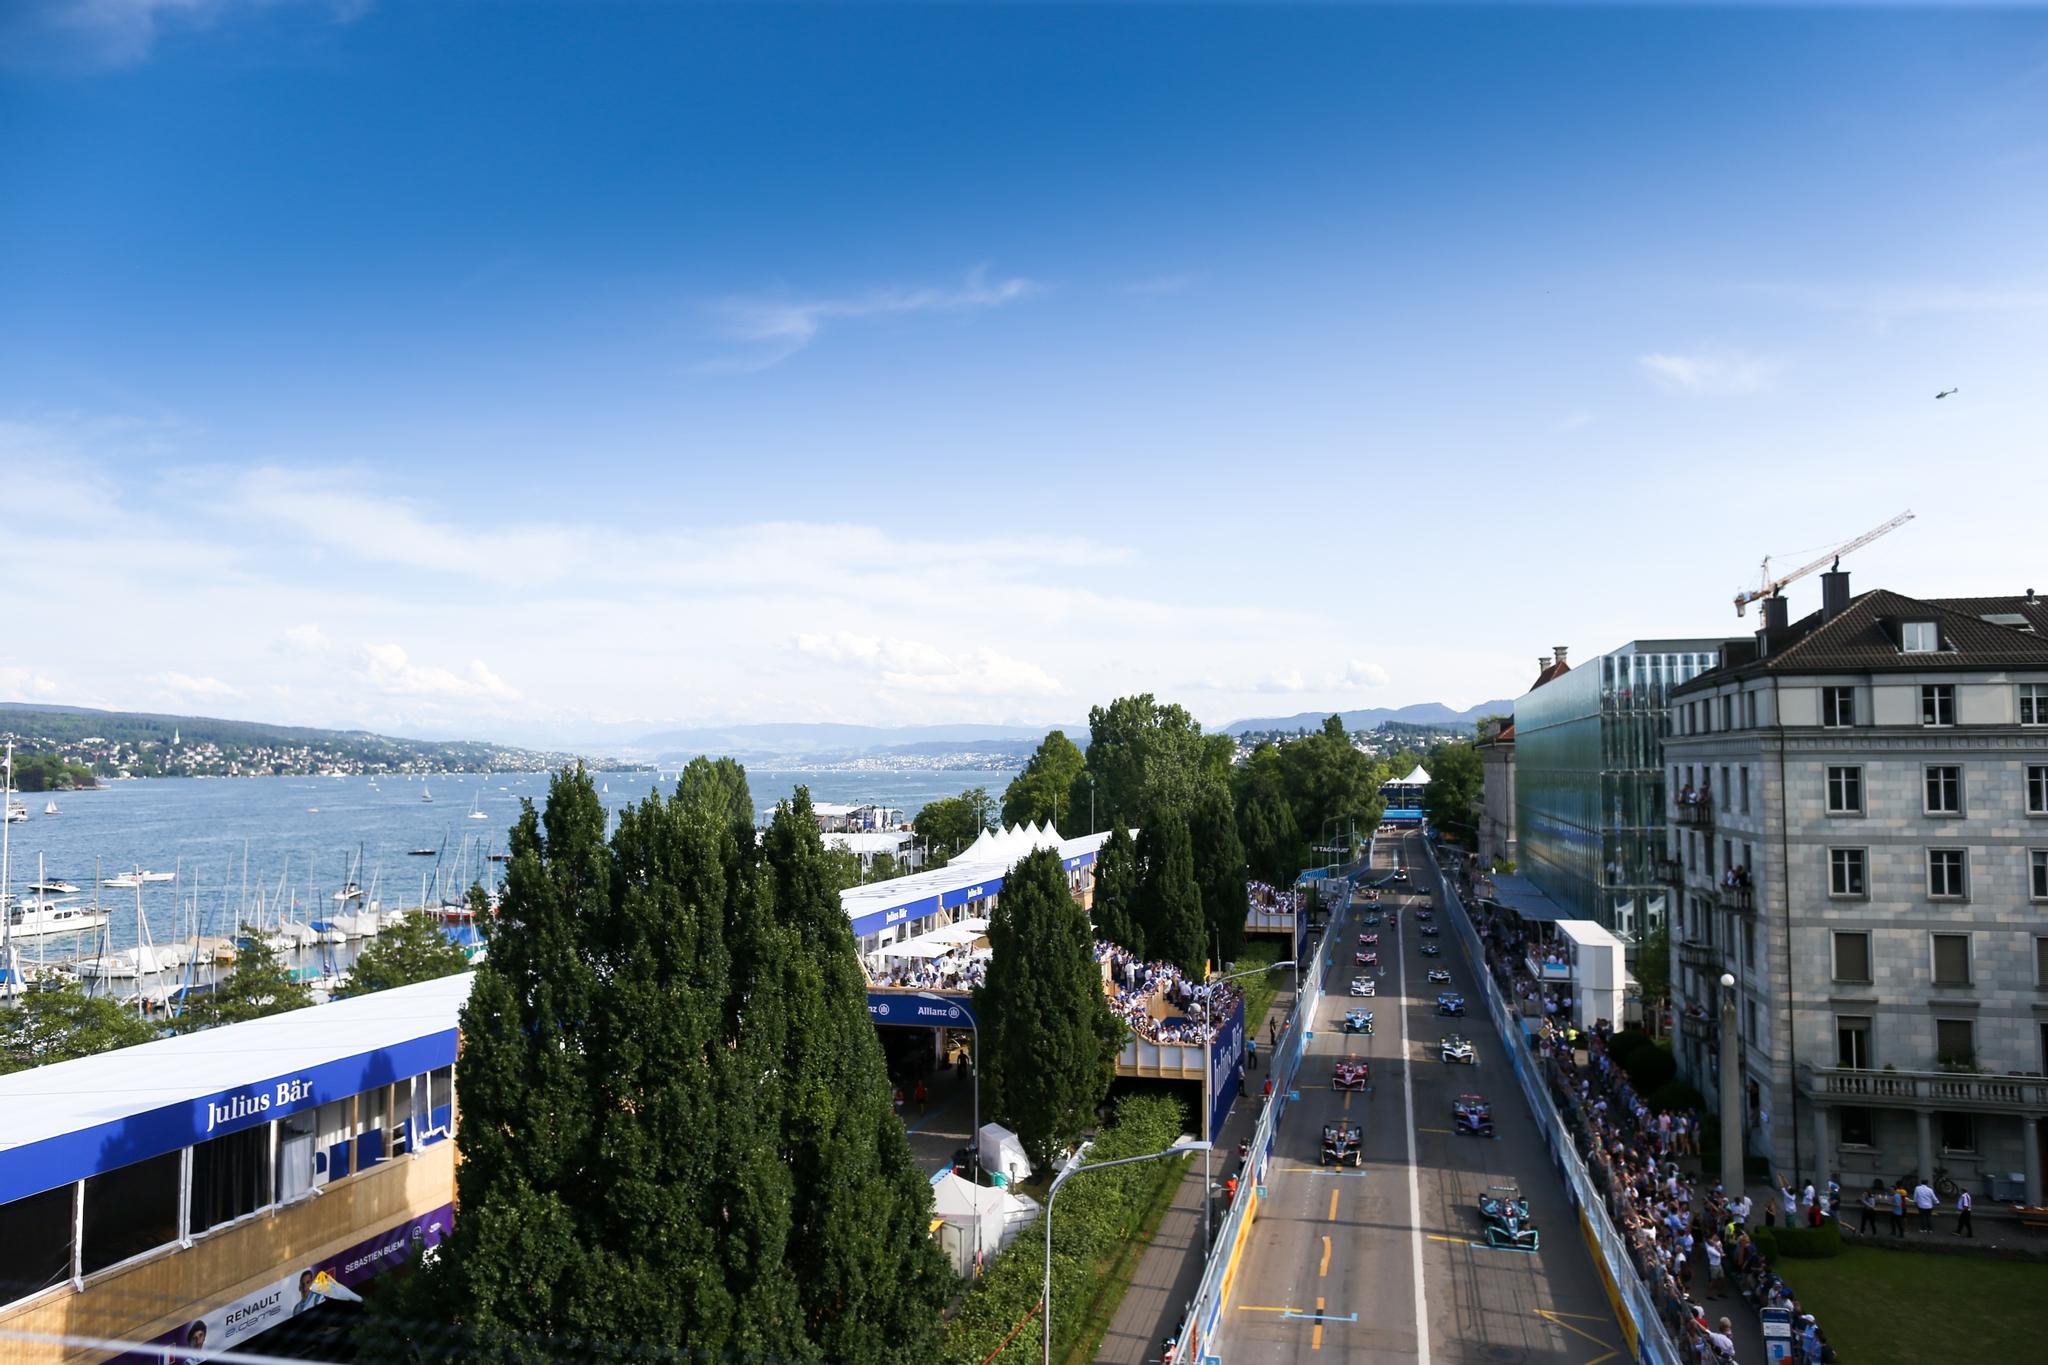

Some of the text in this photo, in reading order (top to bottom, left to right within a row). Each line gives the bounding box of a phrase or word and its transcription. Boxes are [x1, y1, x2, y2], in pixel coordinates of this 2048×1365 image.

[917, 1006, 947, 1016] Allianz
[207, 1079, 313, 1132] Julius Bär
[344, 1239, 405, 1274] SEBASTIEN BUEMI
[225, 1291, 281, 1326] RENAULT
[225, 1305, 281, 1338] e.dams
